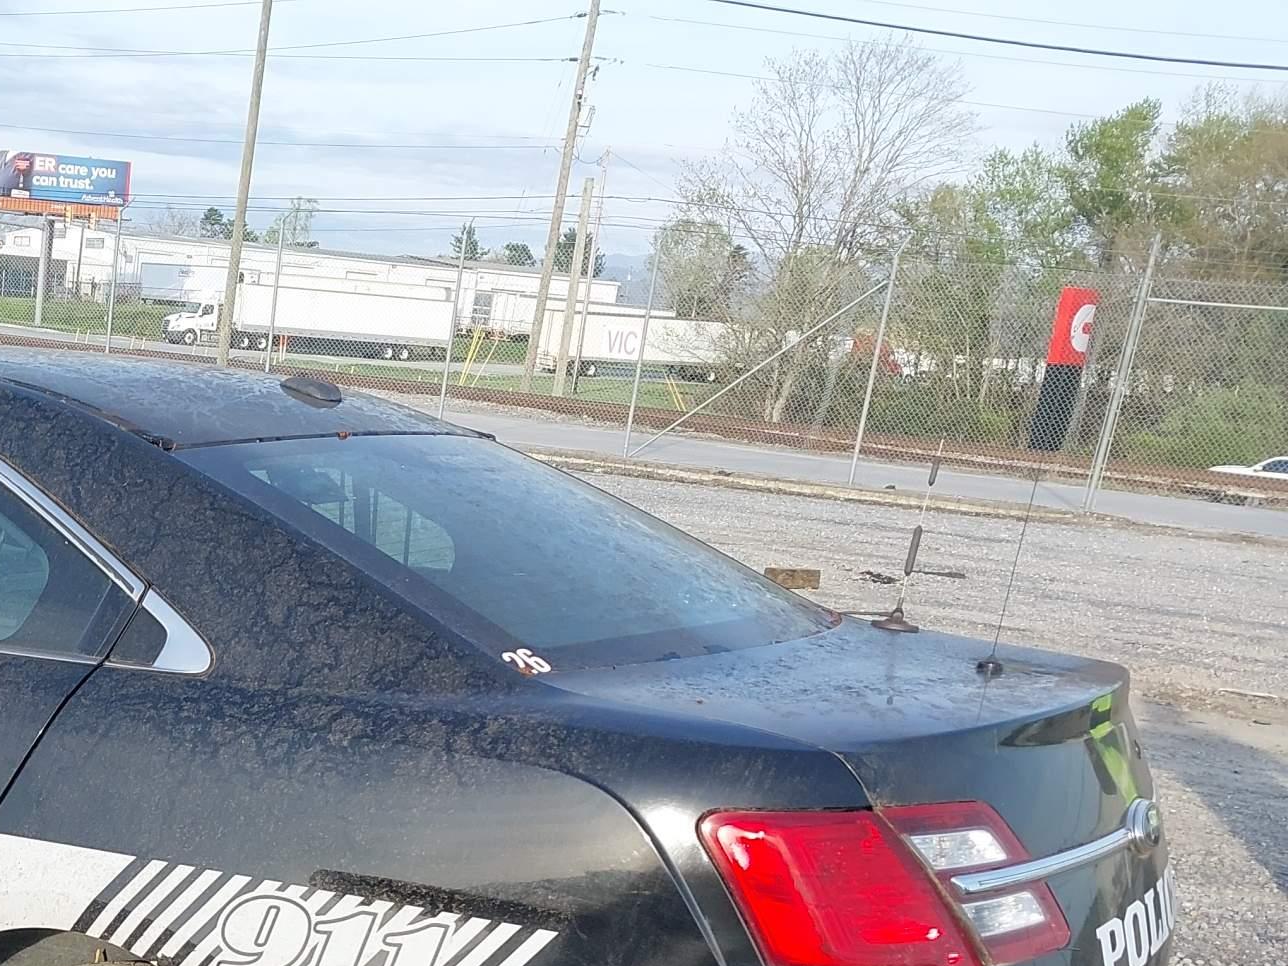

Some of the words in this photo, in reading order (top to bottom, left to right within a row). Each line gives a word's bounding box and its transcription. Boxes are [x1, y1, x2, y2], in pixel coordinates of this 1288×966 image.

[34, 156, 56, 172] ER
[58, 164, 88, 175] care
[89, 166, 116, 179] you
[32, 175, 56, 187] can
[58, 175, 94, 190] trust.
[607, 329, 638, 355] VIC
